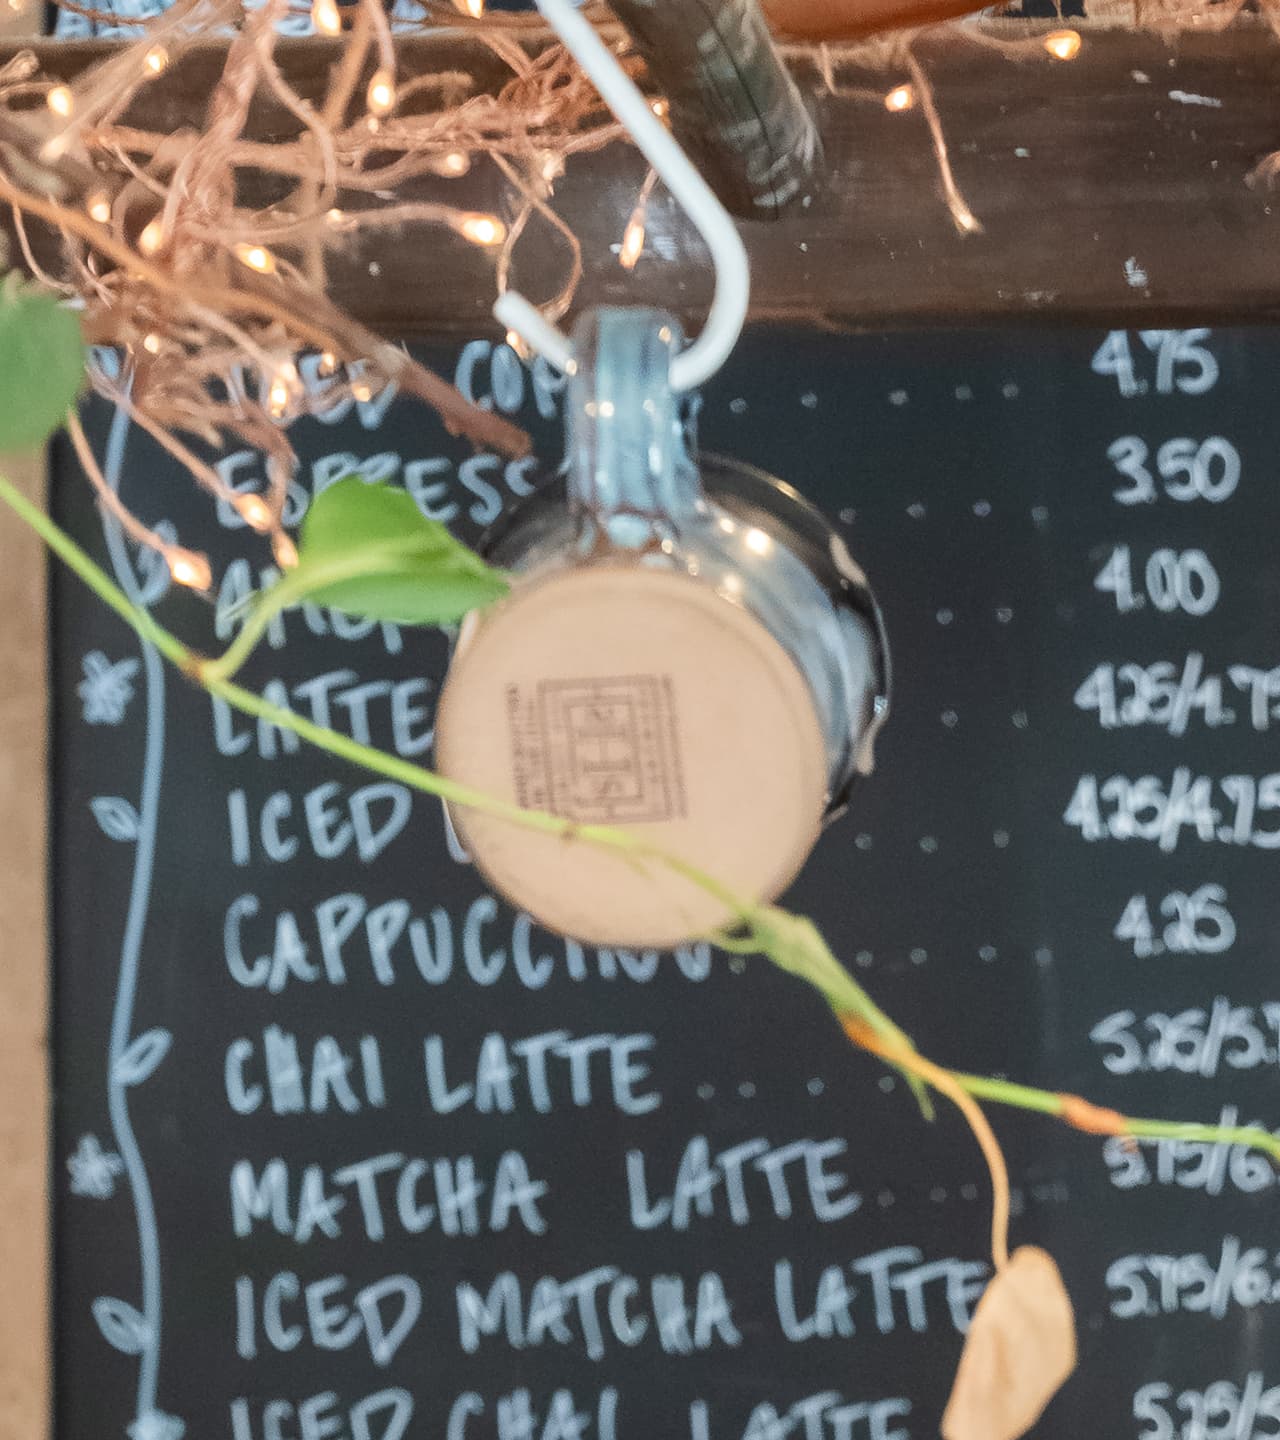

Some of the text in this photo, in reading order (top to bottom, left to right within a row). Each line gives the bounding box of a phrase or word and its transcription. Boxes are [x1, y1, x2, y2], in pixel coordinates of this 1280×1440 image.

[211, 667, 436, 760] LATTE
[228, 780, 412, 866] ICED
[226, 1025, 661, 1114] CHAI LATTE
[231, 1135, 863, 1242] MATCHA LATTE
[236, 1244, 989, 1367] ICED MATCHA LATTE
